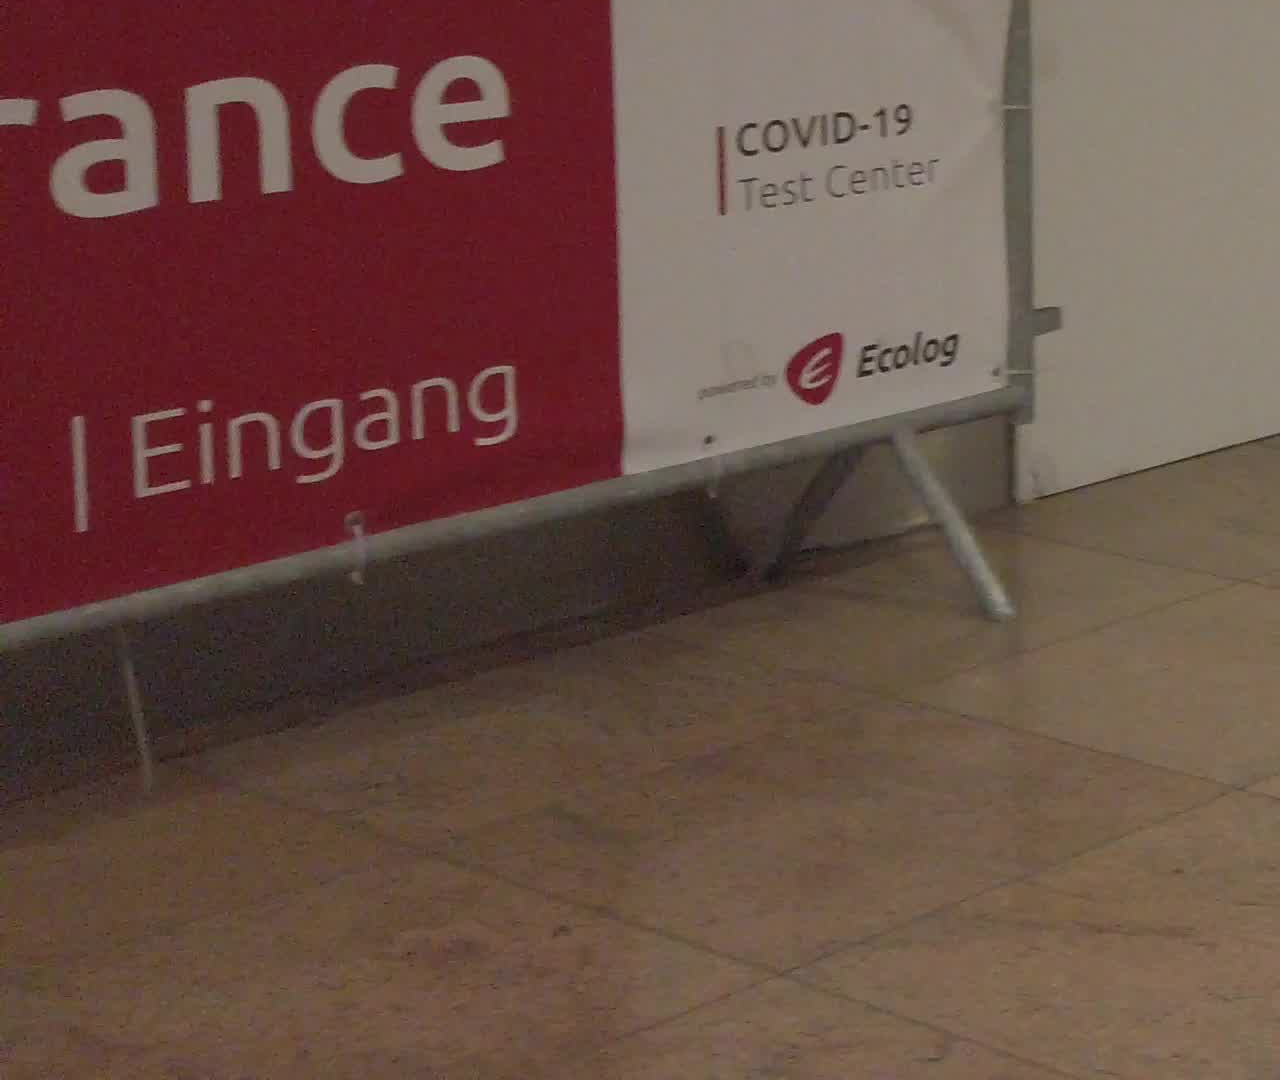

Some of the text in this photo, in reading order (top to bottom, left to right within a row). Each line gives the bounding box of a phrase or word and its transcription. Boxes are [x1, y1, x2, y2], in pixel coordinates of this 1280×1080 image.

[735, 103, 913, 158] COVID-19
[737, 155, 940, 213] Test Center
[856, 331, 960, 379] Ecolog
[129, 364, 520, 498] Eingang
